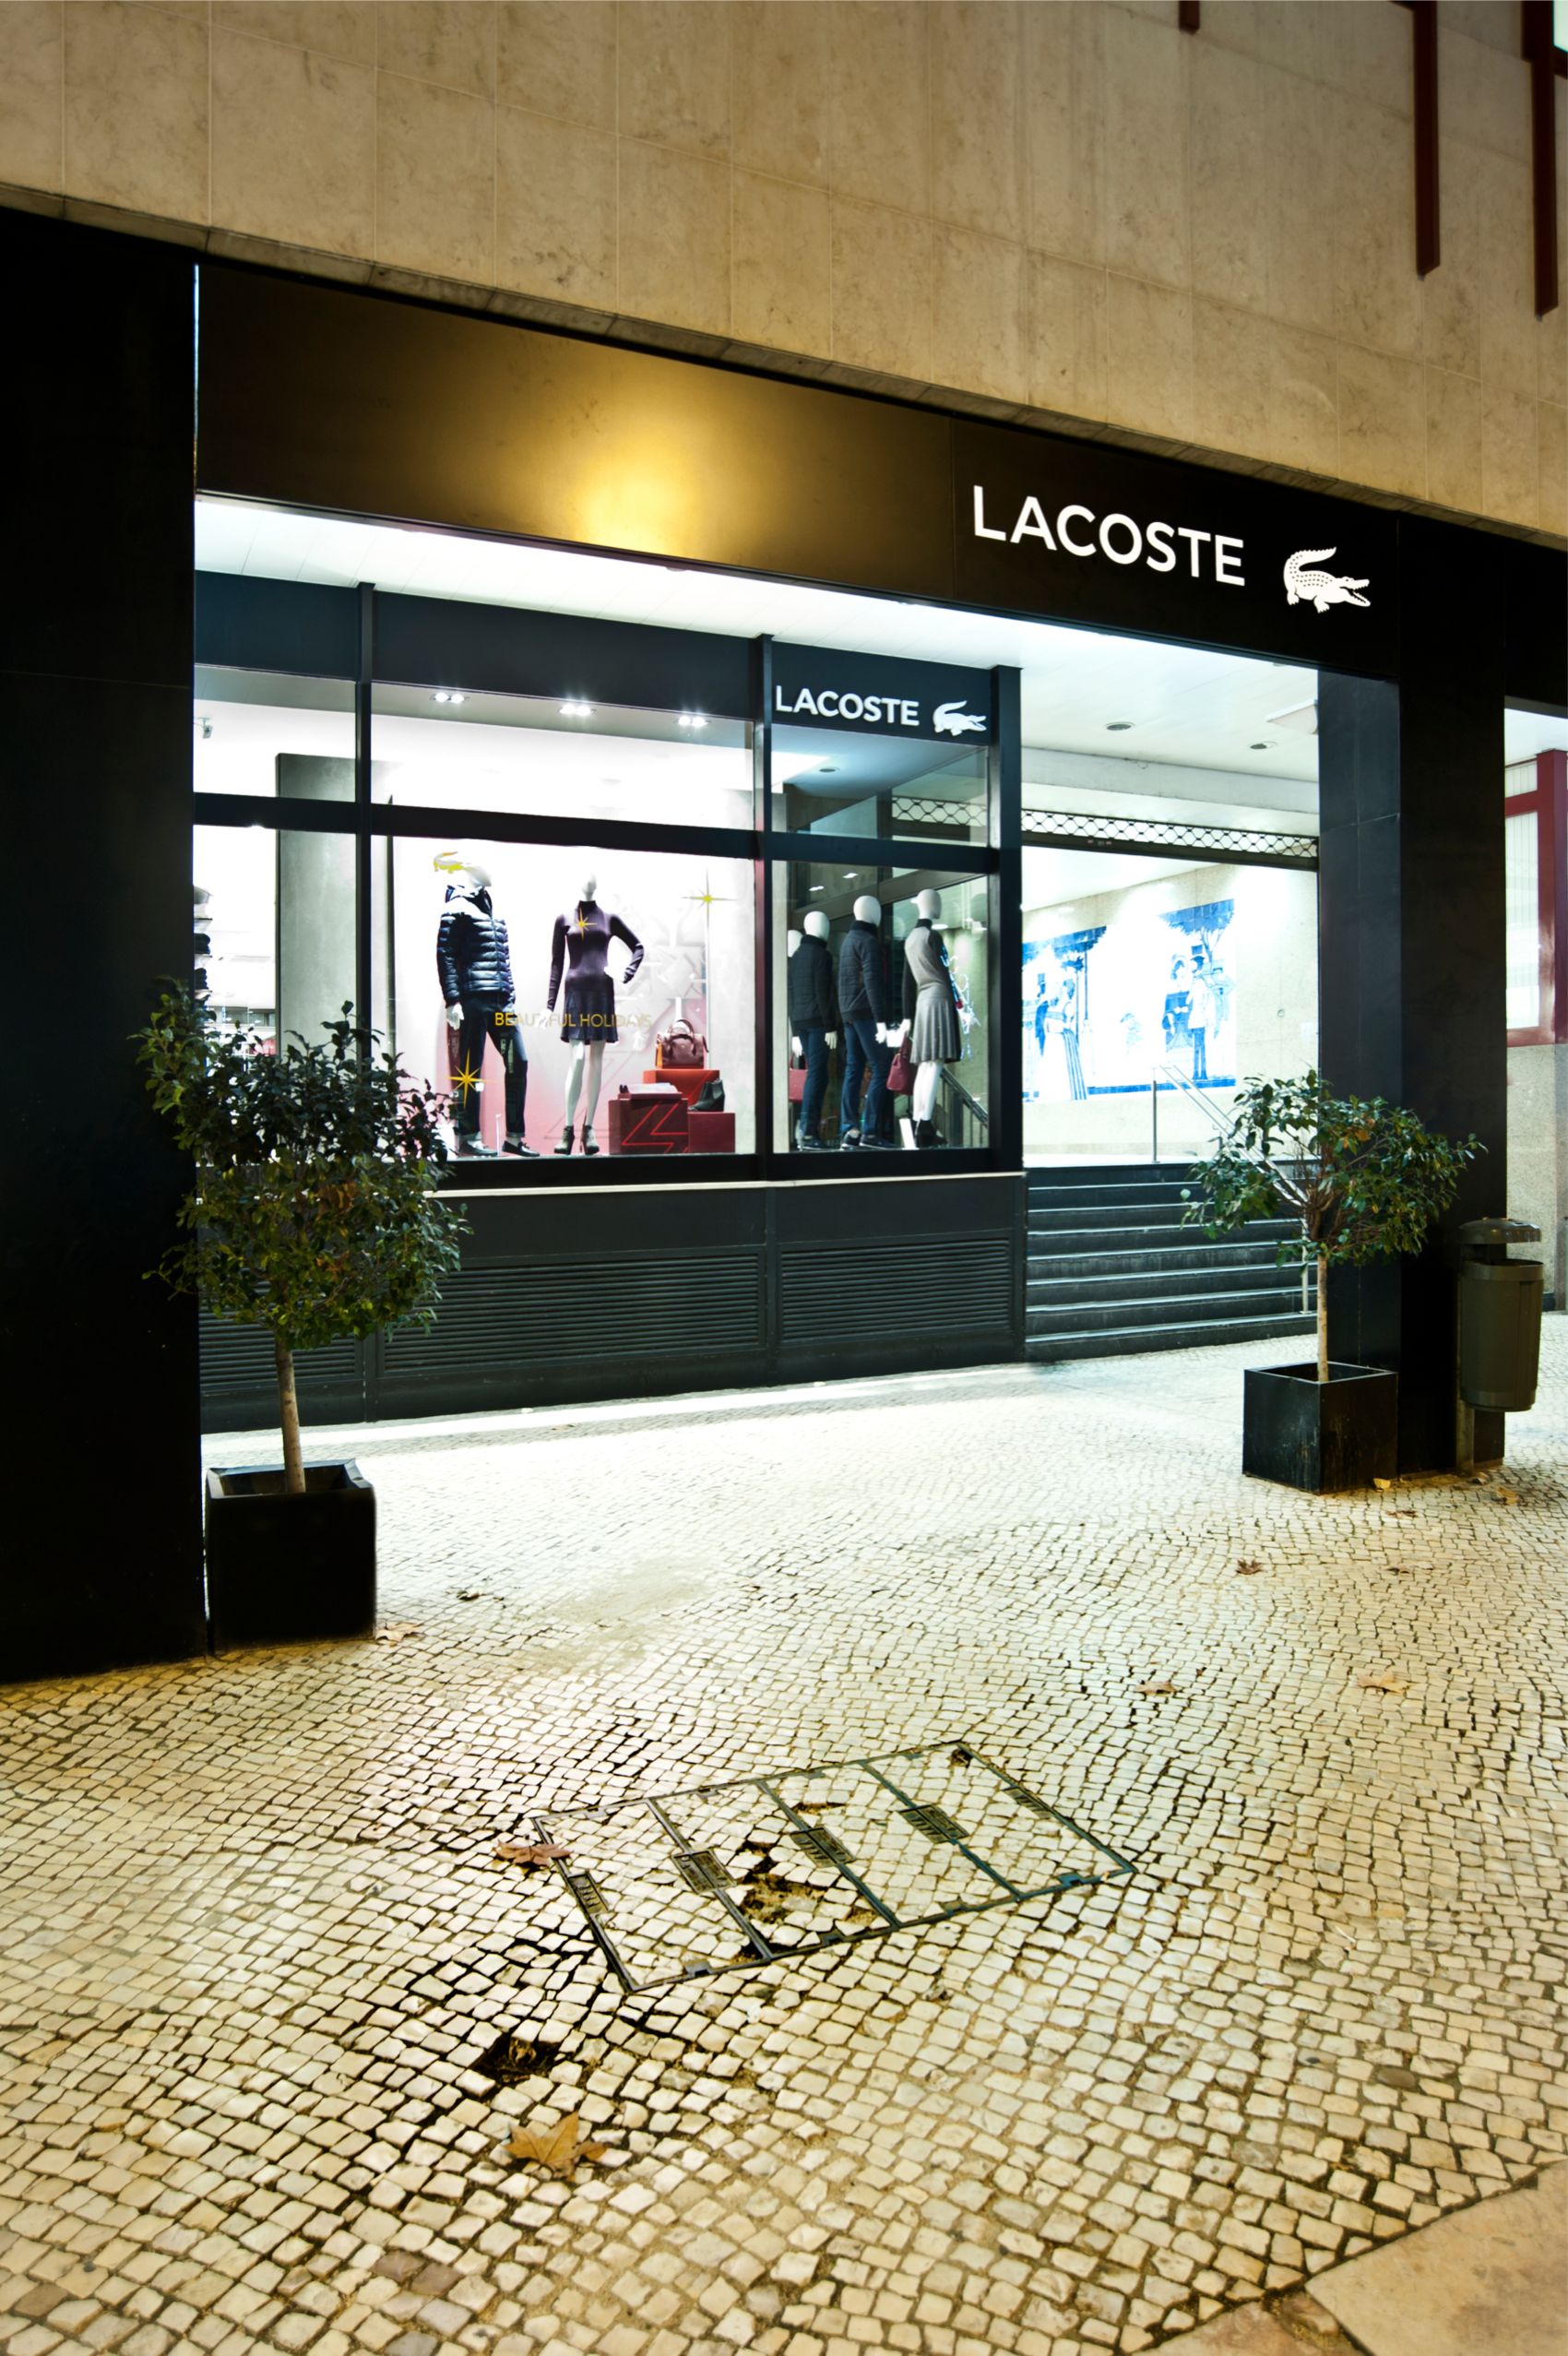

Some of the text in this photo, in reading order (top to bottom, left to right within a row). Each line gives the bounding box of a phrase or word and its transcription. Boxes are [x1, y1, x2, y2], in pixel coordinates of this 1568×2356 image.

[973, 485, 1245, 587] LACOSTE
[776, 684, 920, 726] LACOSTE
[494, 1012, 651, 1028] BEAUTFUL HOLIDAYS
